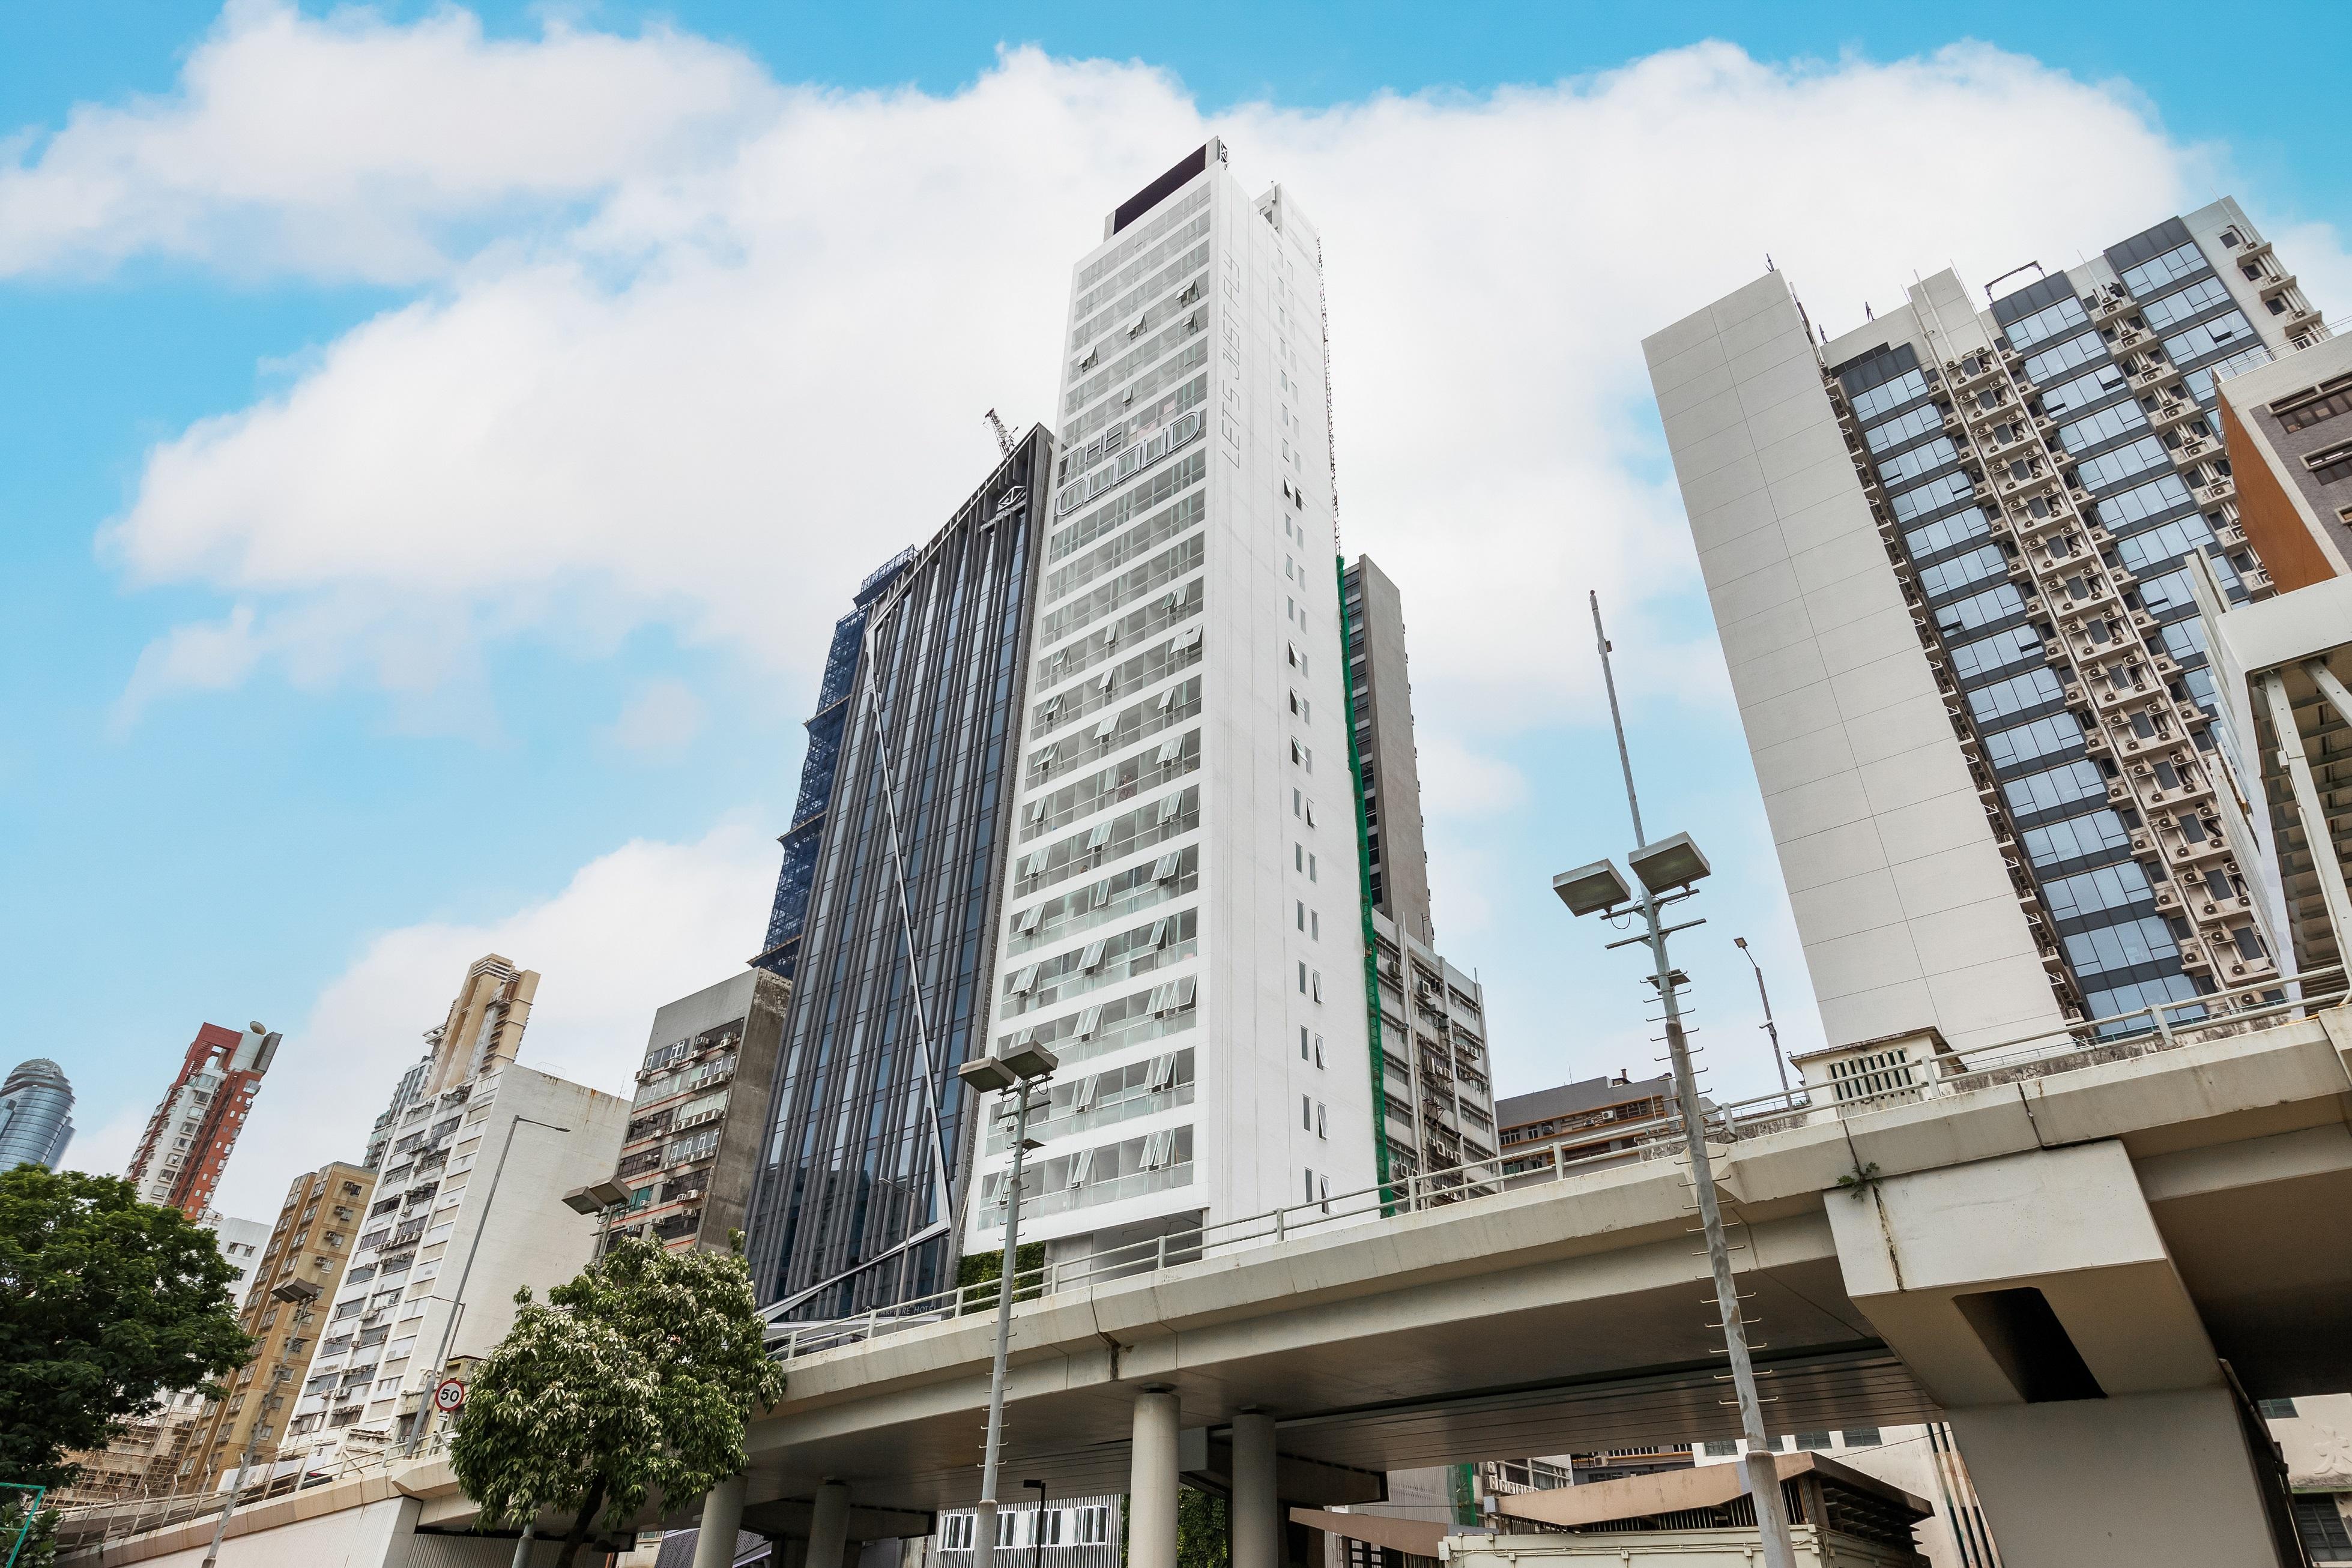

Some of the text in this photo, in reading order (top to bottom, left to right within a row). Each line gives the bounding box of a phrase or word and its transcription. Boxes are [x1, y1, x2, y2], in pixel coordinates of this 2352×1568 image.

[1224, 249, 1240, 309] FLY
[1223, 304, 1240, 380] JUST
[1056, 411, 1201, 516] CLOUD
[1061, 421, 1122, 475] THE
[440, 1388, 460, 1402] 50
